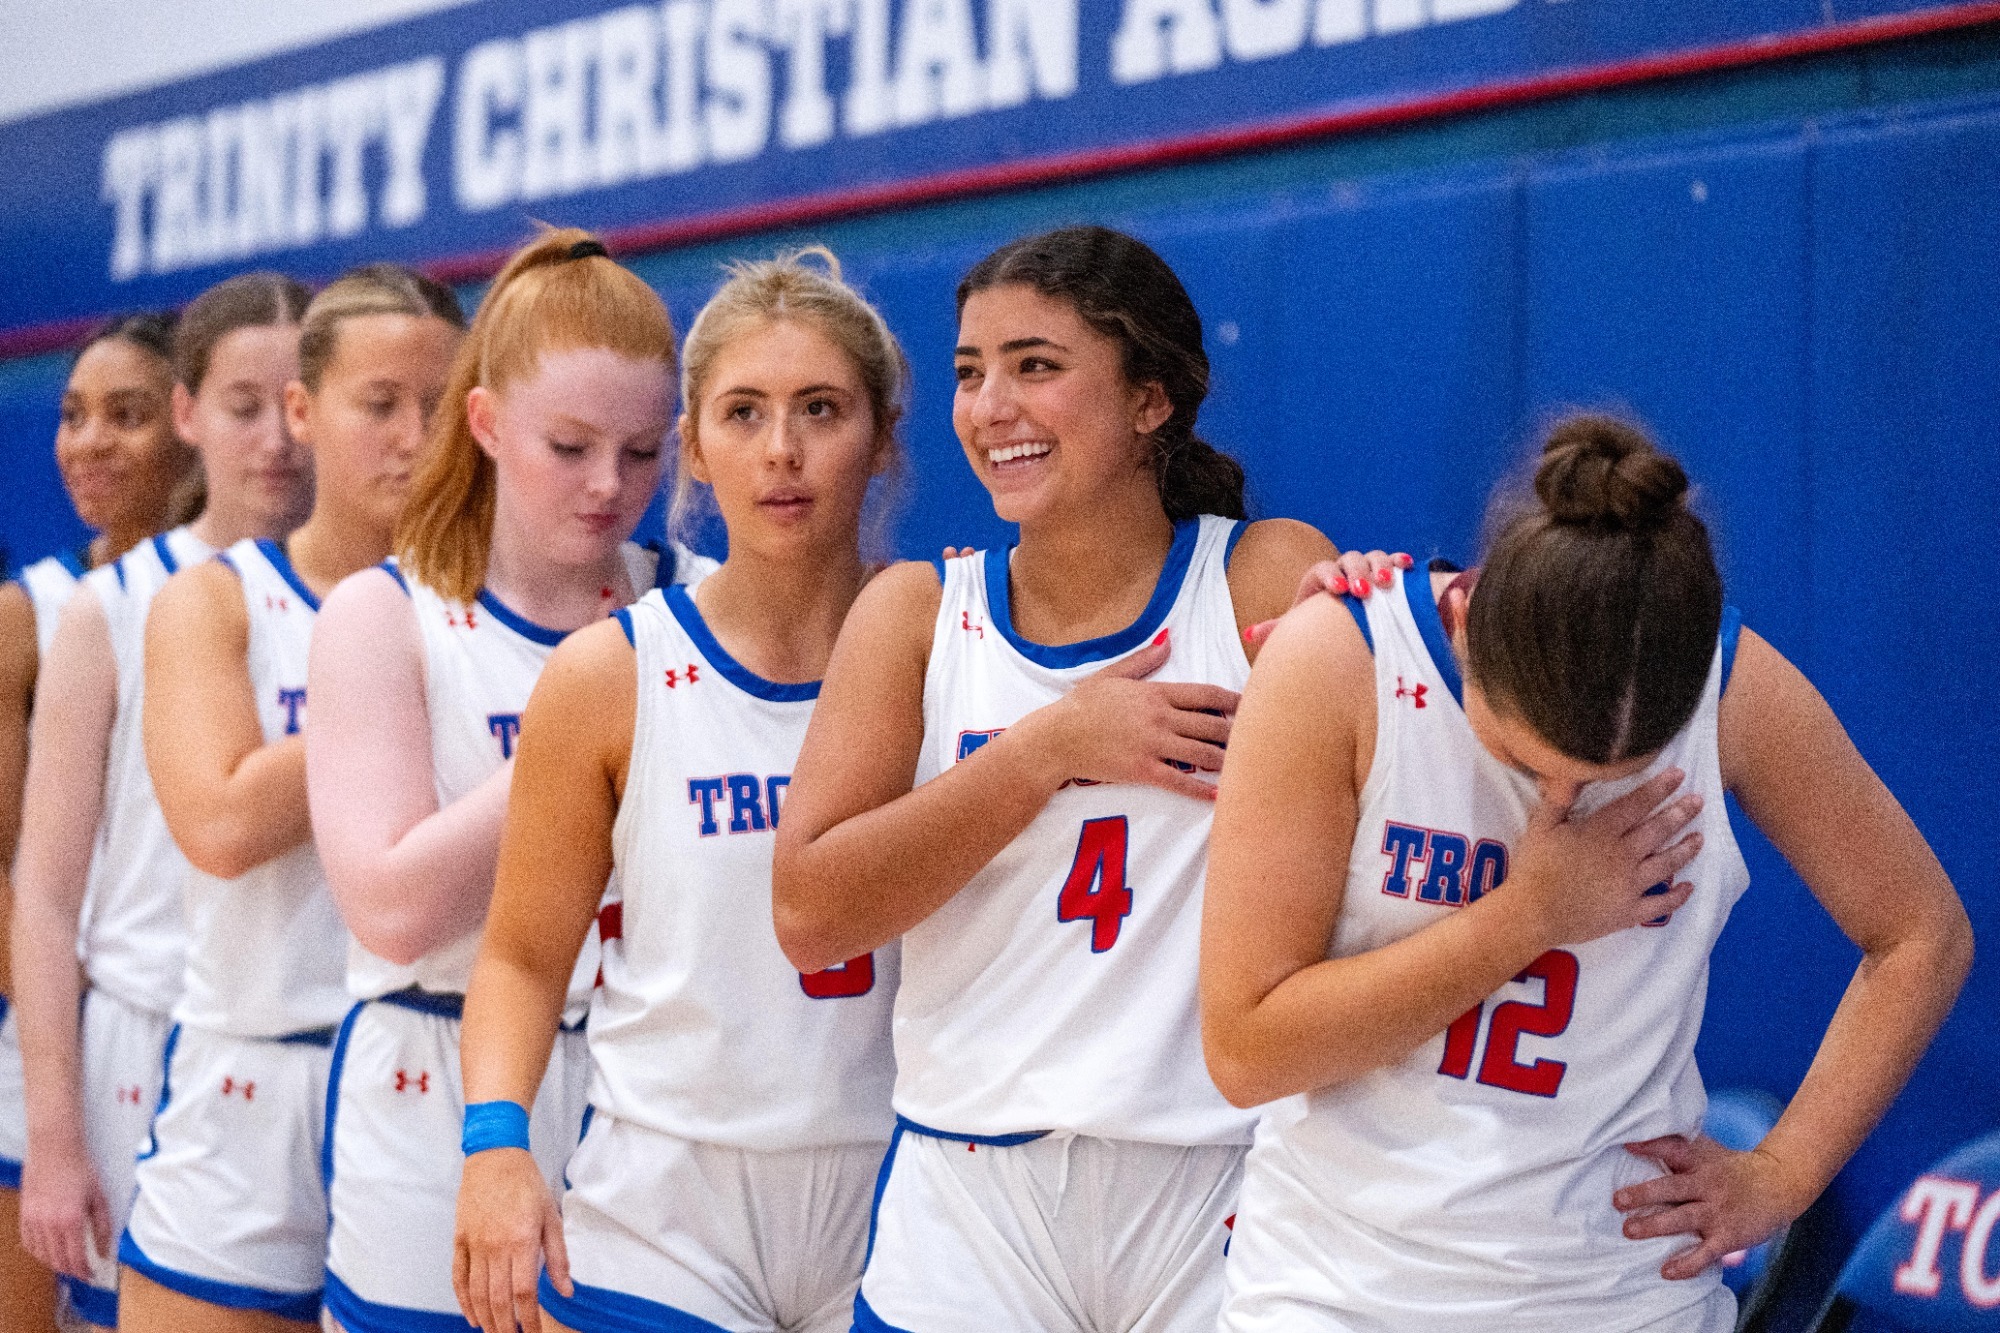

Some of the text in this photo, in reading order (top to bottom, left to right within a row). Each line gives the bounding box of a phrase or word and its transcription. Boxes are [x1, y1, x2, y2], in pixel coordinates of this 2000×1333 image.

[103, 0, 1077, 282] TRINITY CHRISTIAN
[1057, 815, 1133, 954] 4
